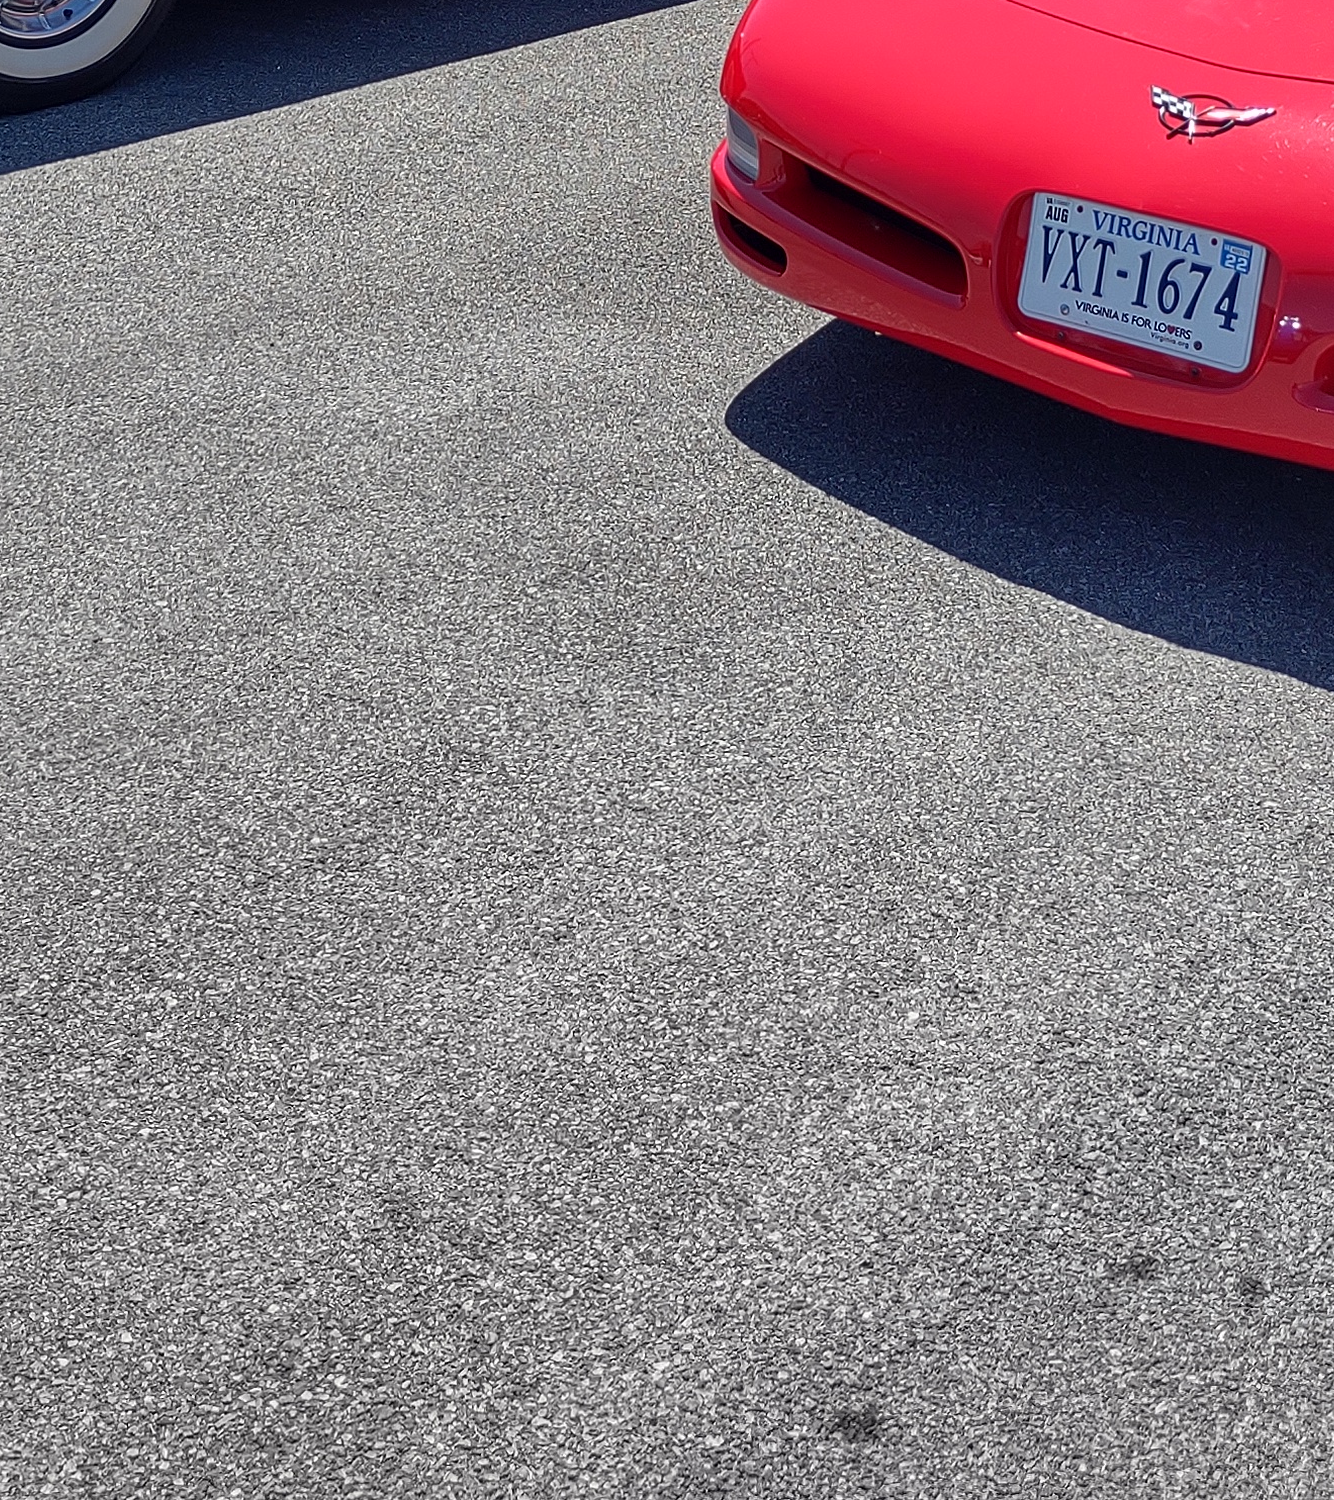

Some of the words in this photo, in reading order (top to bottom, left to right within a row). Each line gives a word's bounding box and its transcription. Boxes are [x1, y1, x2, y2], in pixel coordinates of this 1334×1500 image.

[1045, 205, 1069, 223] AUG
[1092, 209, 1201, 256] VIRGINIA
[1224, 252, 1248, 272] 22
[1041, 225, 1241, 333] VXT-1674
[1075, 299, 1120, 321] VIRGINIA
[1121, 312, 1130, 323] IS
[1131, 315, 1152, 330] FOR
[1149, 331, 1190, 350] Virginia.org
